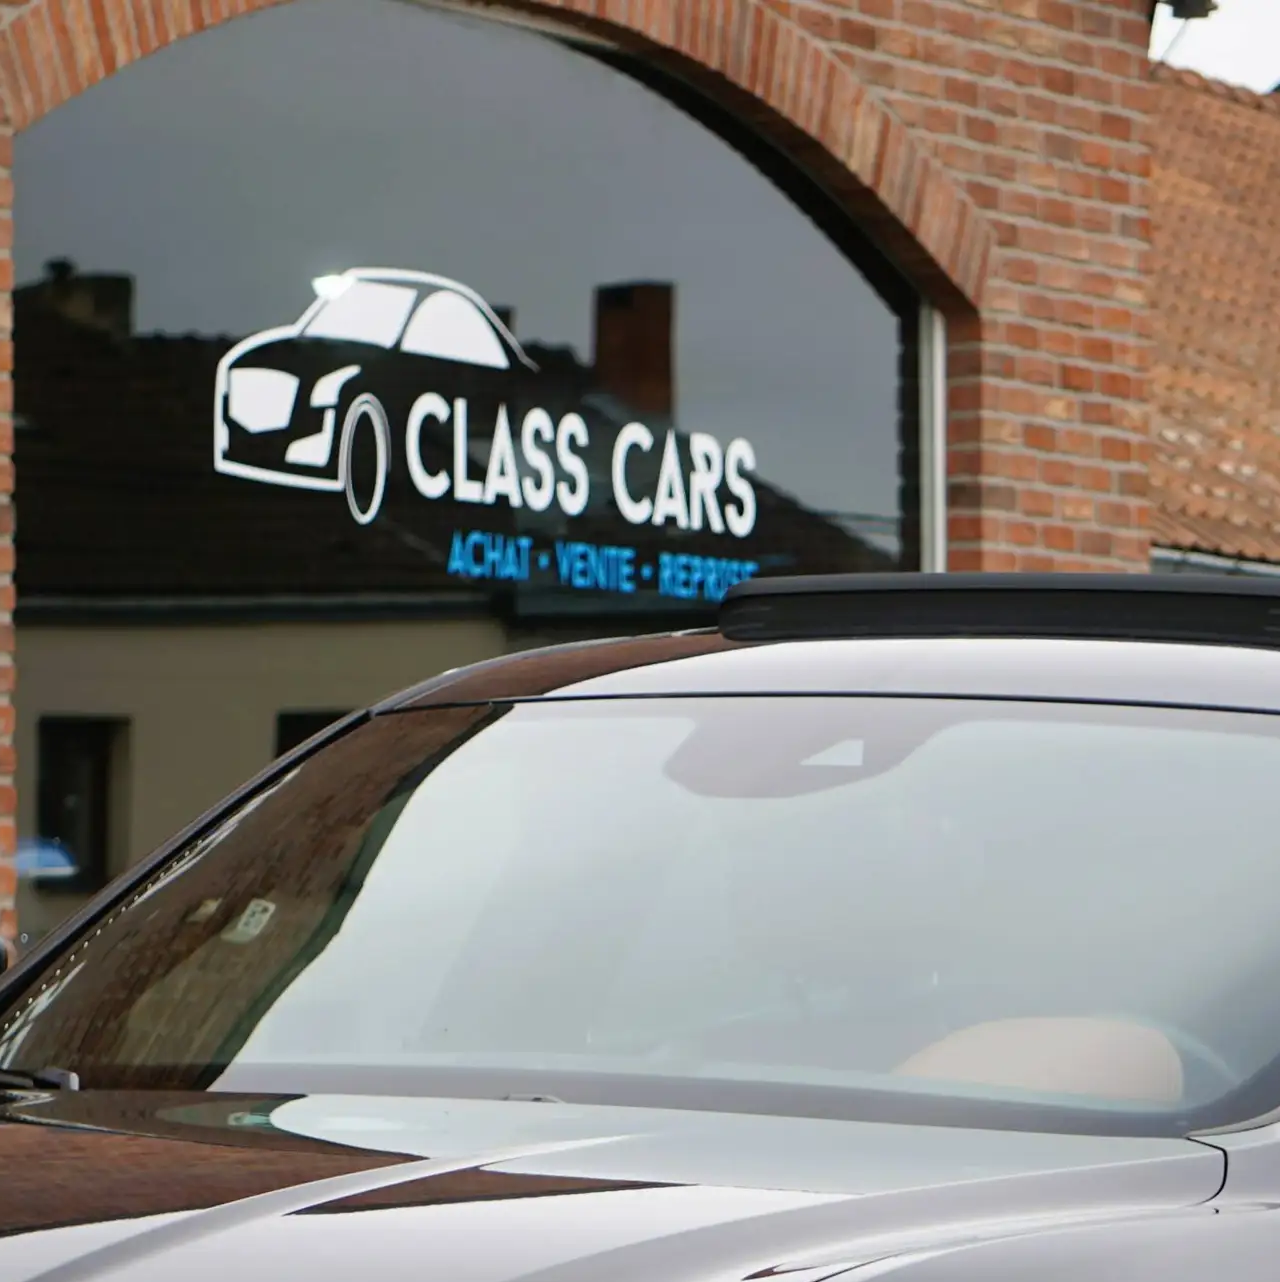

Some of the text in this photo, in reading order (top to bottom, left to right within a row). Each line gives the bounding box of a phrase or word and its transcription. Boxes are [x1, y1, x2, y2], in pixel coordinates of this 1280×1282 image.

[405, 392, 756, 537] CLASS CARS
[447, 530, 532, 580] ACHAT
[555, 539, 636, 592] VENTE
